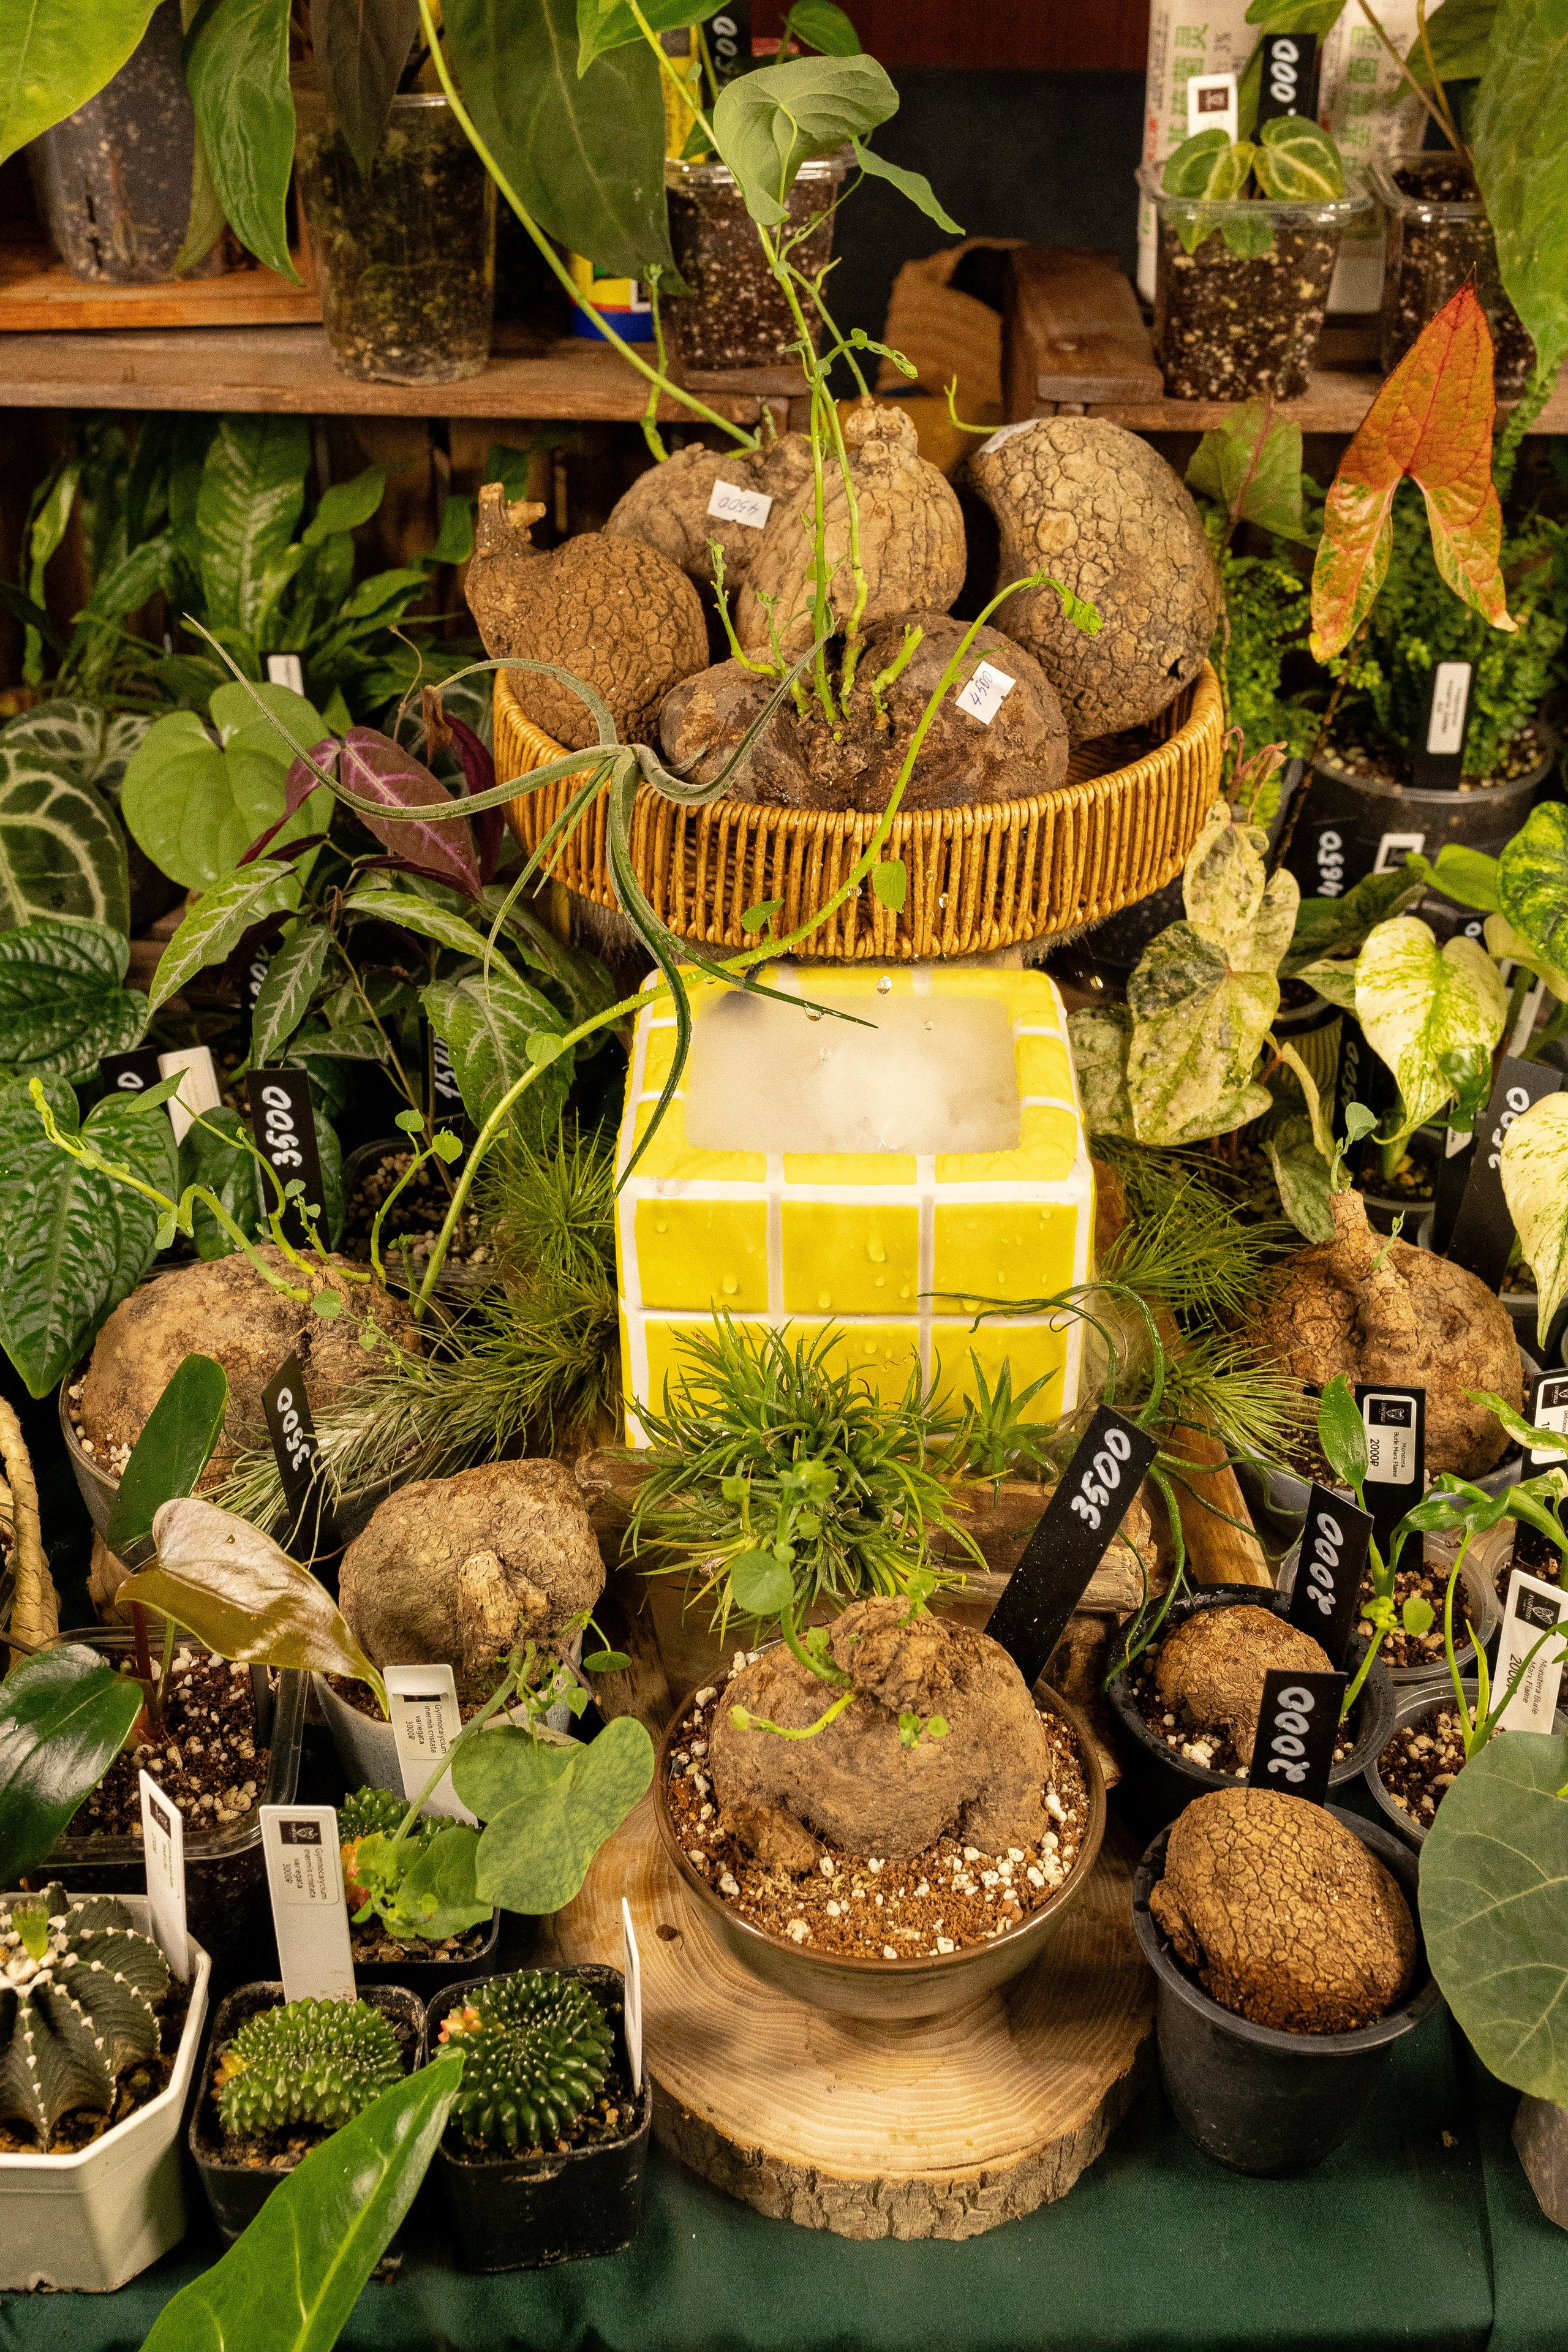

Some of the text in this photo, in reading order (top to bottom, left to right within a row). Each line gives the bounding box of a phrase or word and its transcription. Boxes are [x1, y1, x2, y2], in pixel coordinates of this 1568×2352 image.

[970, 671, 993, 706] 4500
[262, 1086, 303, 1167] 3500
[277, 1387, 310, 1471] 3500
[1071, 1428, 1131, 1529] 3500
[1307, 1513, 1343, 1615] 2000
[1522, 1660, 1536, 1704] Marx Flame
[1532, 1658, 1548, 1715] Monstera Burle
[415, 1715, 424, 1744] variegata
[424, 1705, 437, 1753] inermis cristata
[434, 1704, 447, 1754] Gymnocalycium
[1267, 1686, 1315, 1783] 2000
